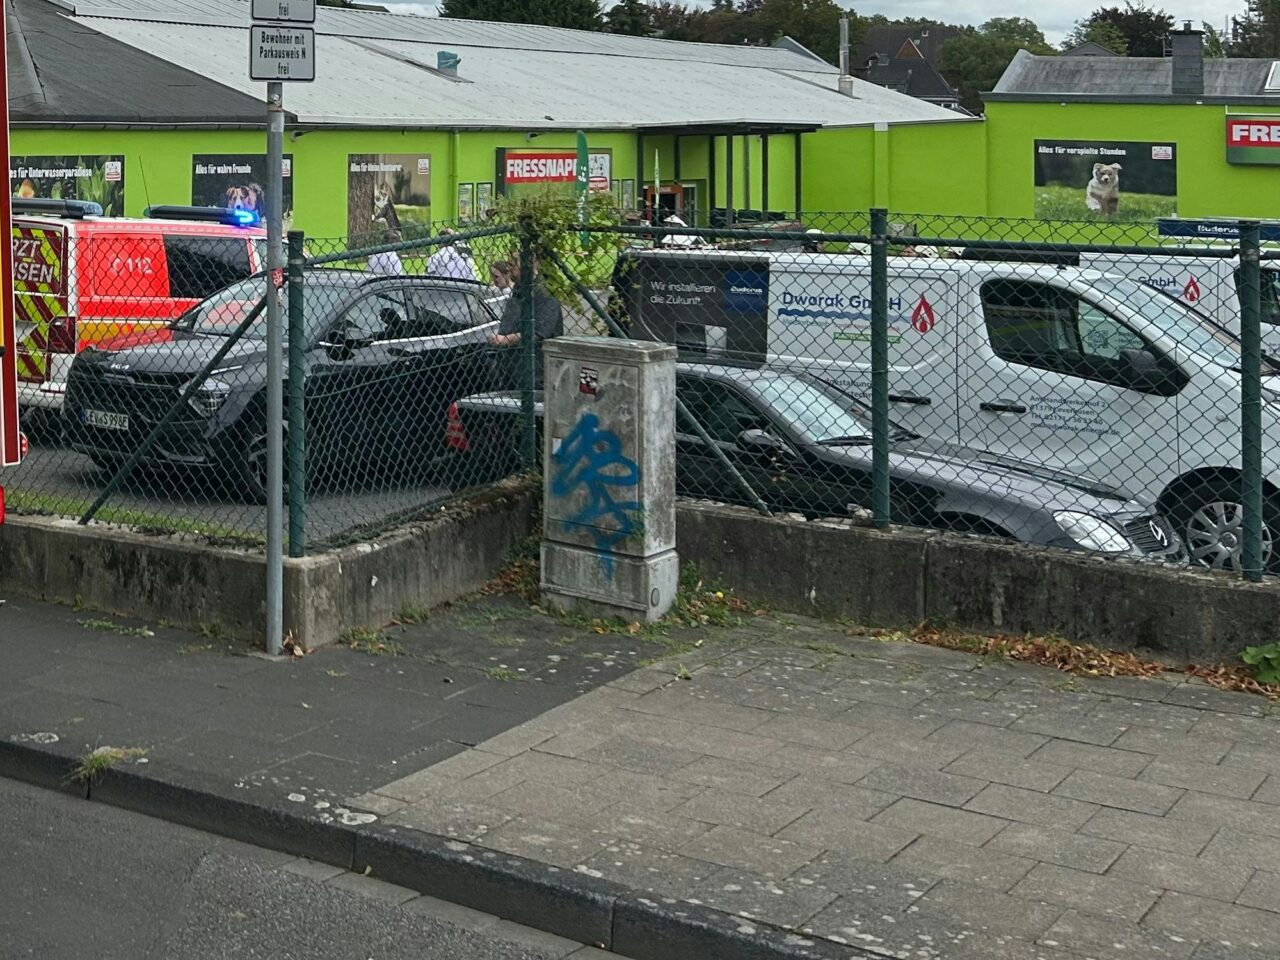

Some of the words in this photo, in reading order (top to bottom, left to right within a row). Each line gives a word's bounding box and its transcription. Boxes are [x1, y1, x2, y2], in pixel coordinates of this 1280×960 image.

[278, 2, 289, 17] frei
[261, 30, 293, 45] Bewohner
[294, 32, 305, 45] mit
[259, 45, 300, 59] Parkausweis
[277, 62, 289, 75] frei
[1038, 145, 1053, 154] Alles
[1055, 145, 1066, 154] für
[1066, 146, 1099, 156] verspielte
[1099, 146, 1127, 156] Stunden
[18, 167, 29, 178] für
[28, 166, 93, 180] Unterwasserparadiese
[195, 163, 208, 175] Alles
[208, 163, 217, 174] für
[232, 163, 252, 174] Freunde
[1197, 224, 1240, 234] Buderus
[12, 238, 41, 258] RZT
[650, 281, 666, 292] Wir
[668, 281, 717, 293] installieren
[650, 294, 665, 304] die
[782, 291, 844, 308] Dworak
[849, 294, 902, 311] GmH
